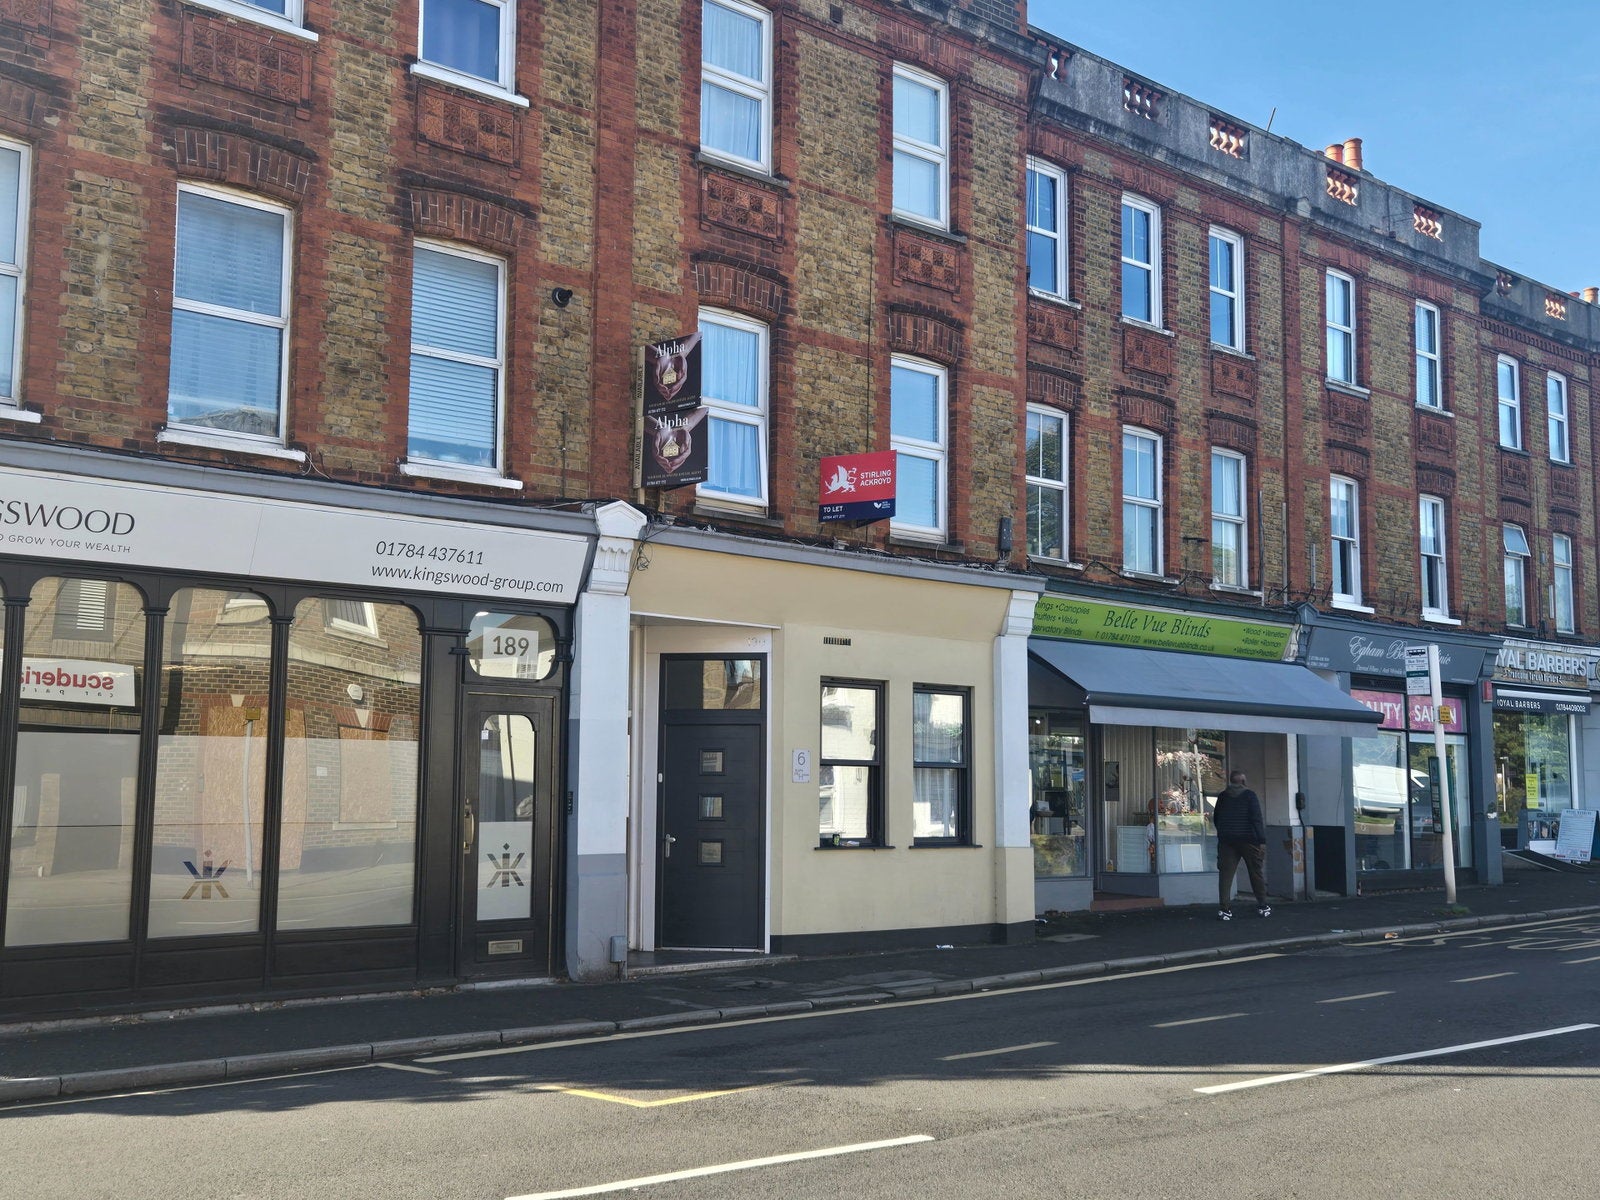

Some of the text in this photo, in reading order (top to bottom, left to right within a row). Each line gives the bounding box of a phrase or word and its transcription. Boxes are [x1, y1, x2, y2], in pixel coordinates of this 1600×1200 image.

[655, 341, 685, 360] Alpha
[655, 413, 689, 431] Alpha
[860, 469, 892, 480] STIRLING
[860, 477, 892, 487] ACKROYD
[823, 505, 843, 513] TO LET
[8, 534, 46, 546] GROW
[50, 538, 81, 549] YOUR
[85, 541, 131, 554] WEALTH
[376, 540, 484, 565] 01784 437611
[371, 565, 564, 593] www.kingswood-group.com
[1103, 609, 1212, 638] Belle Vue Blinds
[493, 635, 530, 657] 189
[1349, 635, 1385, 663] Egham
[1495, 648, 1524, 669] YAL
[1525, 650, 1587, 677] BARBERS
[1515, 700, 1541, 710] BARBERS
[797, 751, 806, 766] 6
